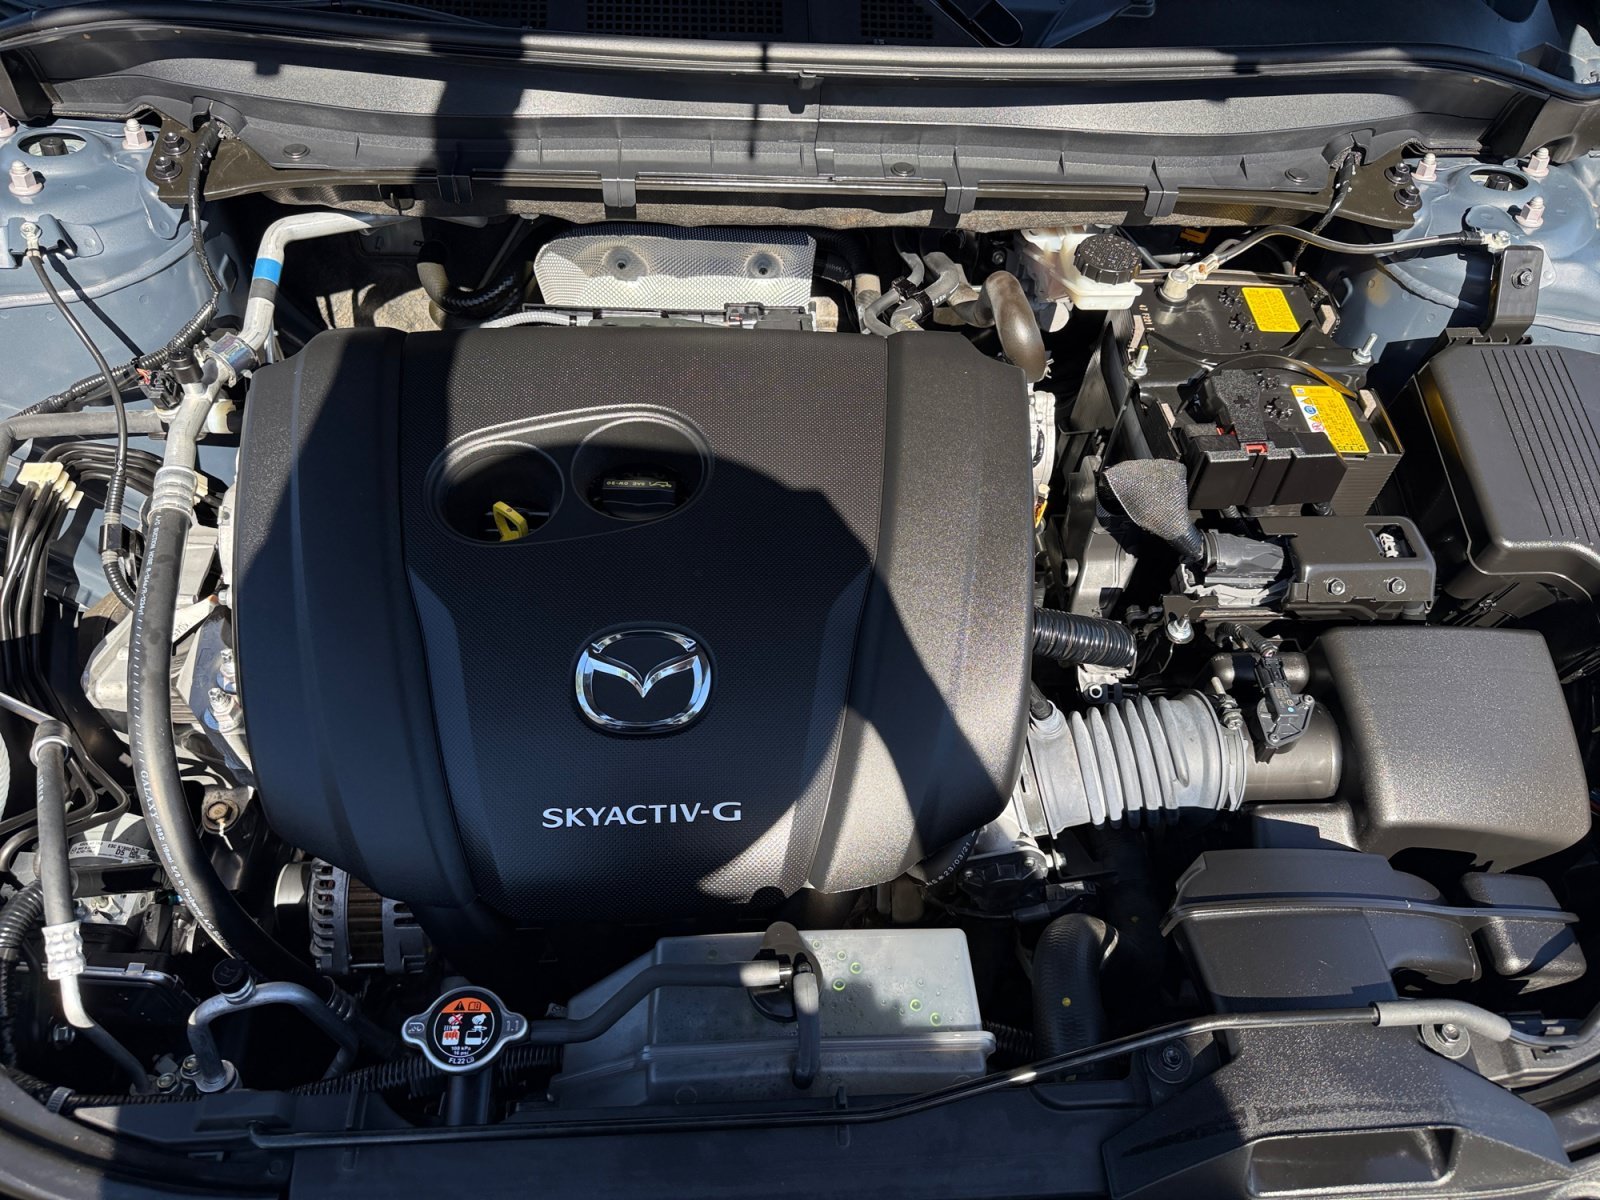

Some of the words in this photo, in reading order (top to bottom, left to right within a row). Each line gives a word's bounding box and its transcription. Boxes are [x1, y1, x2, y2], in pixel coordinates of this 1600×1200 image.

[150, 527, 159, 549] SUCTION
[146, 550, 156, 566] HOSE
[140, 770, 160, 820] GALAXY
[542, 801, 742, 829] SKYACTIV-G
[448, 1057, 466, 1065] FL22
